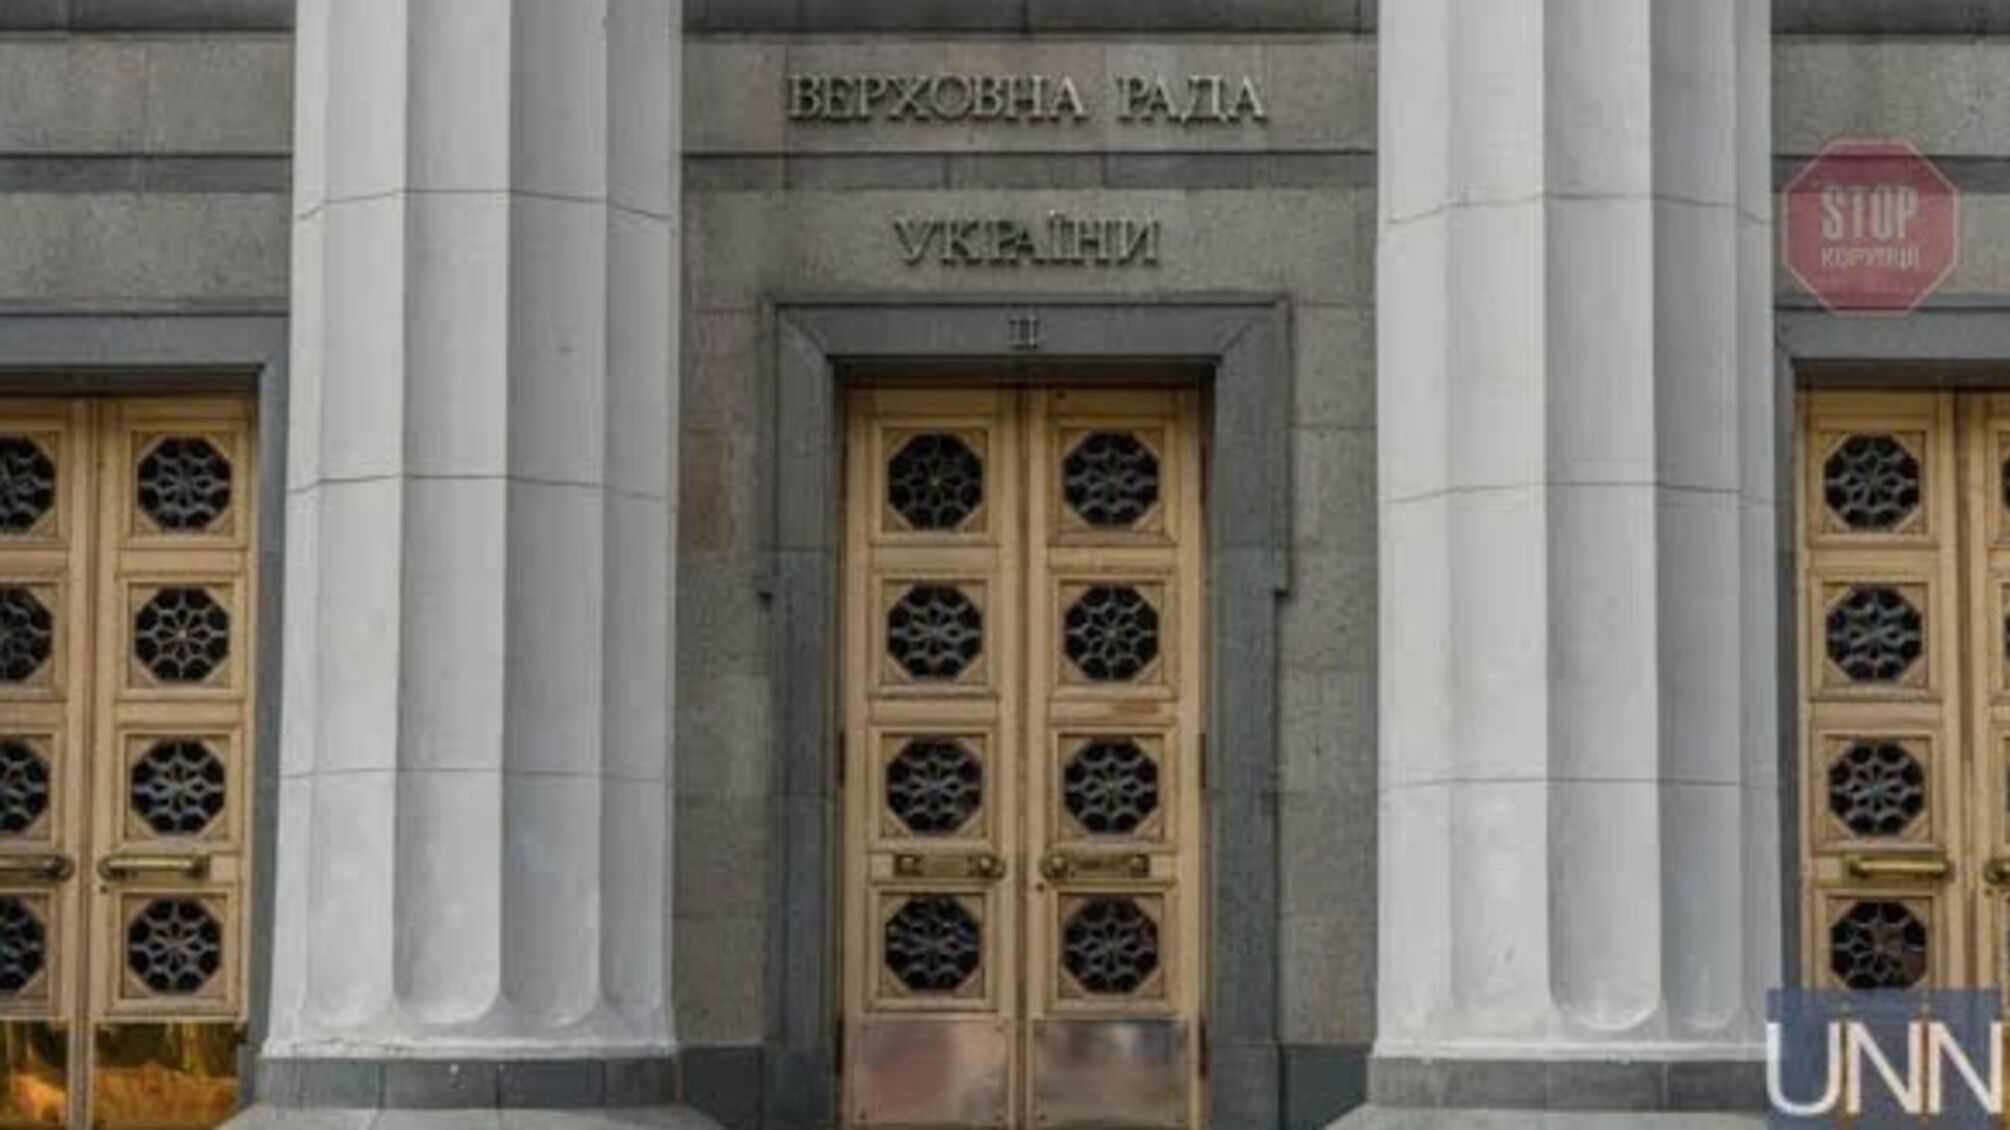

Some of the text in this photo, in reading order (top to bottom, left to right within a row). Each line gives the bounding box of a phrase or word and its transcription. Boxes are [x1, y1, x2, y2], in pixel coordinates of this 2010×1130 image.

[787, 74, 1269, 124] ВЕРХОВНА РАДА
[892, 210, 1161, 267] УКРАЇНИ
